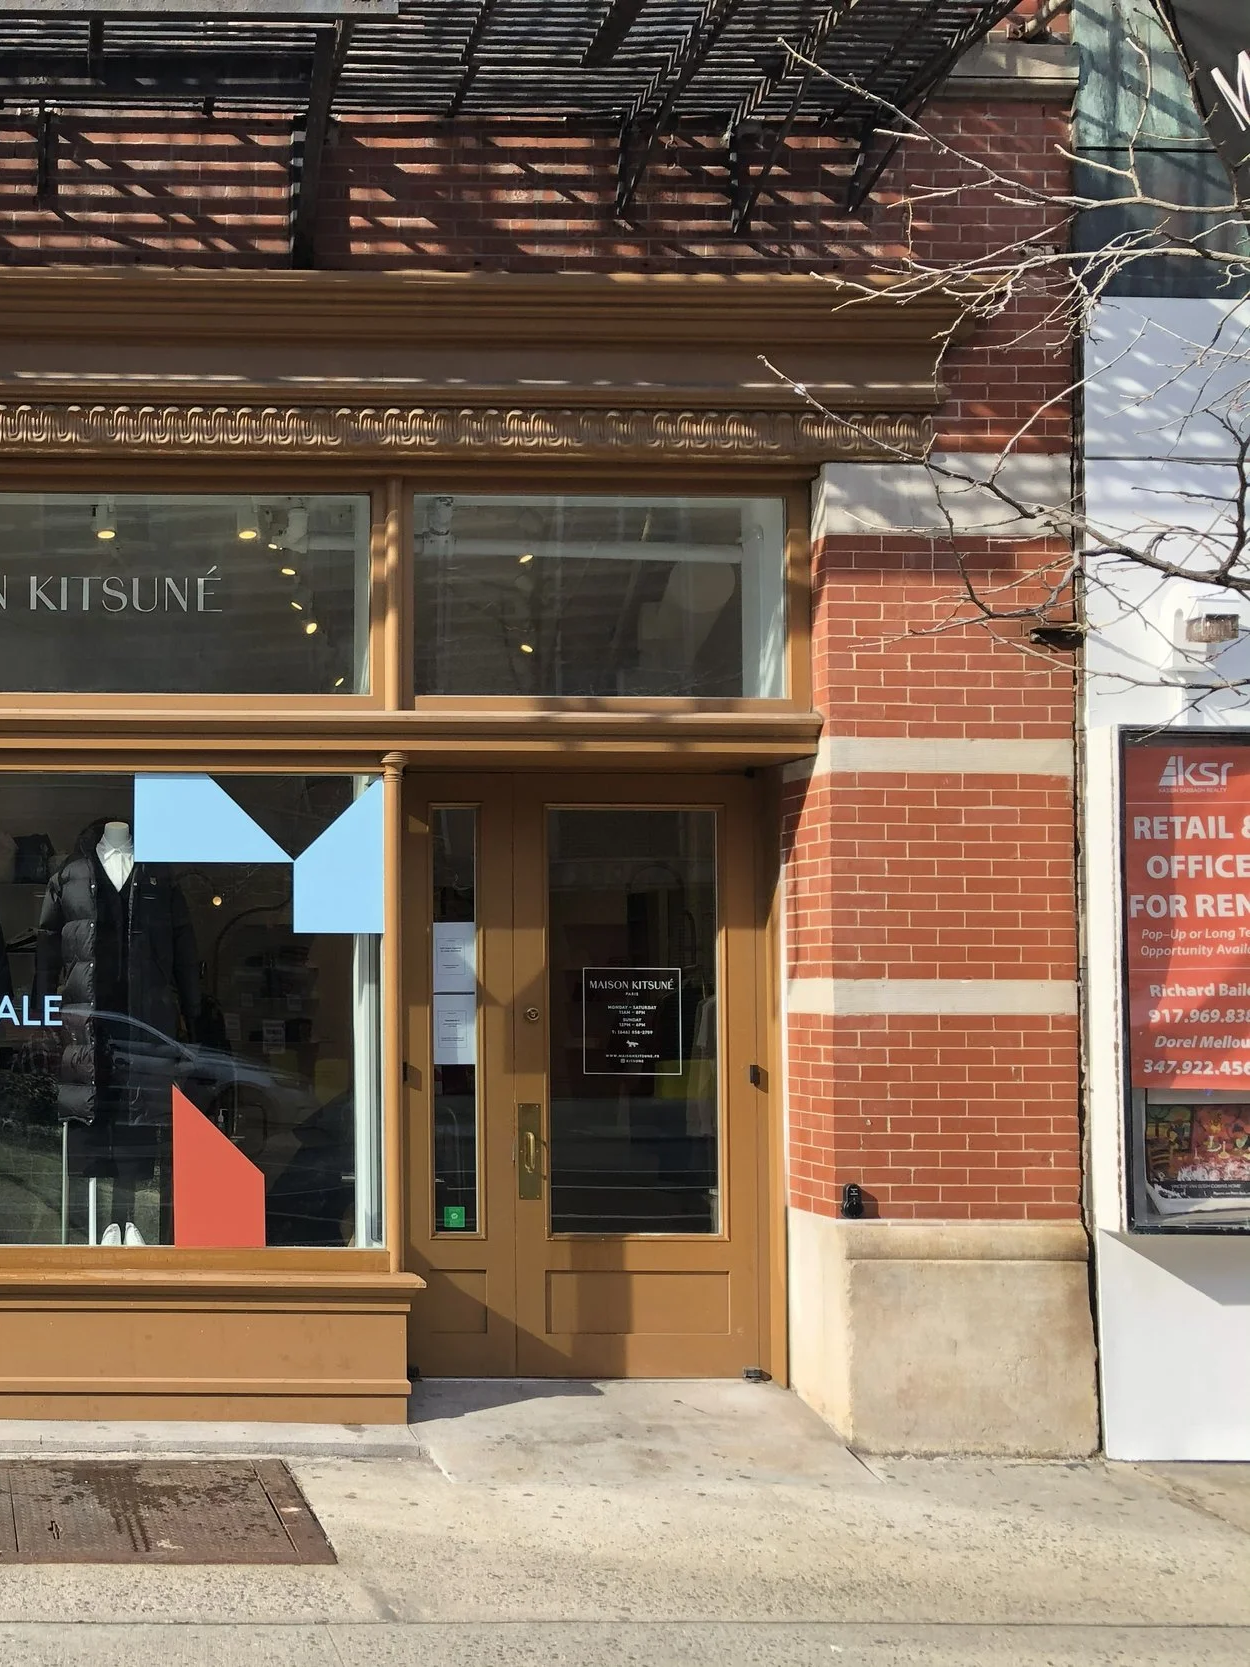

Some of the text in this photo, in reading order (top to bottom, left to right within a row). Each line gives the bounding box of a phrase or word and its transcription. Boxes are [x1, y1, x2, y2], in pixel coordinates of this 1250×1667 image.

[29, 565, 223, 612] KITSUNÉ
[1133, 815, 1234, 840] RETAIL
[1146, 854, 1250, 879] OFFICE
[1130, 894, 1189, 918] FOR
[1189, 929, 1202, 939] or
[1205, 928, 1236, 941] Long
[1141, 945, 1214, 958] Opportunity
[589, 978, 675, 990] MAISON KITSUNÉ
[1149, 982, 1215, 997] Richard
[1154, 1035, 1198, 1048] Dorel
